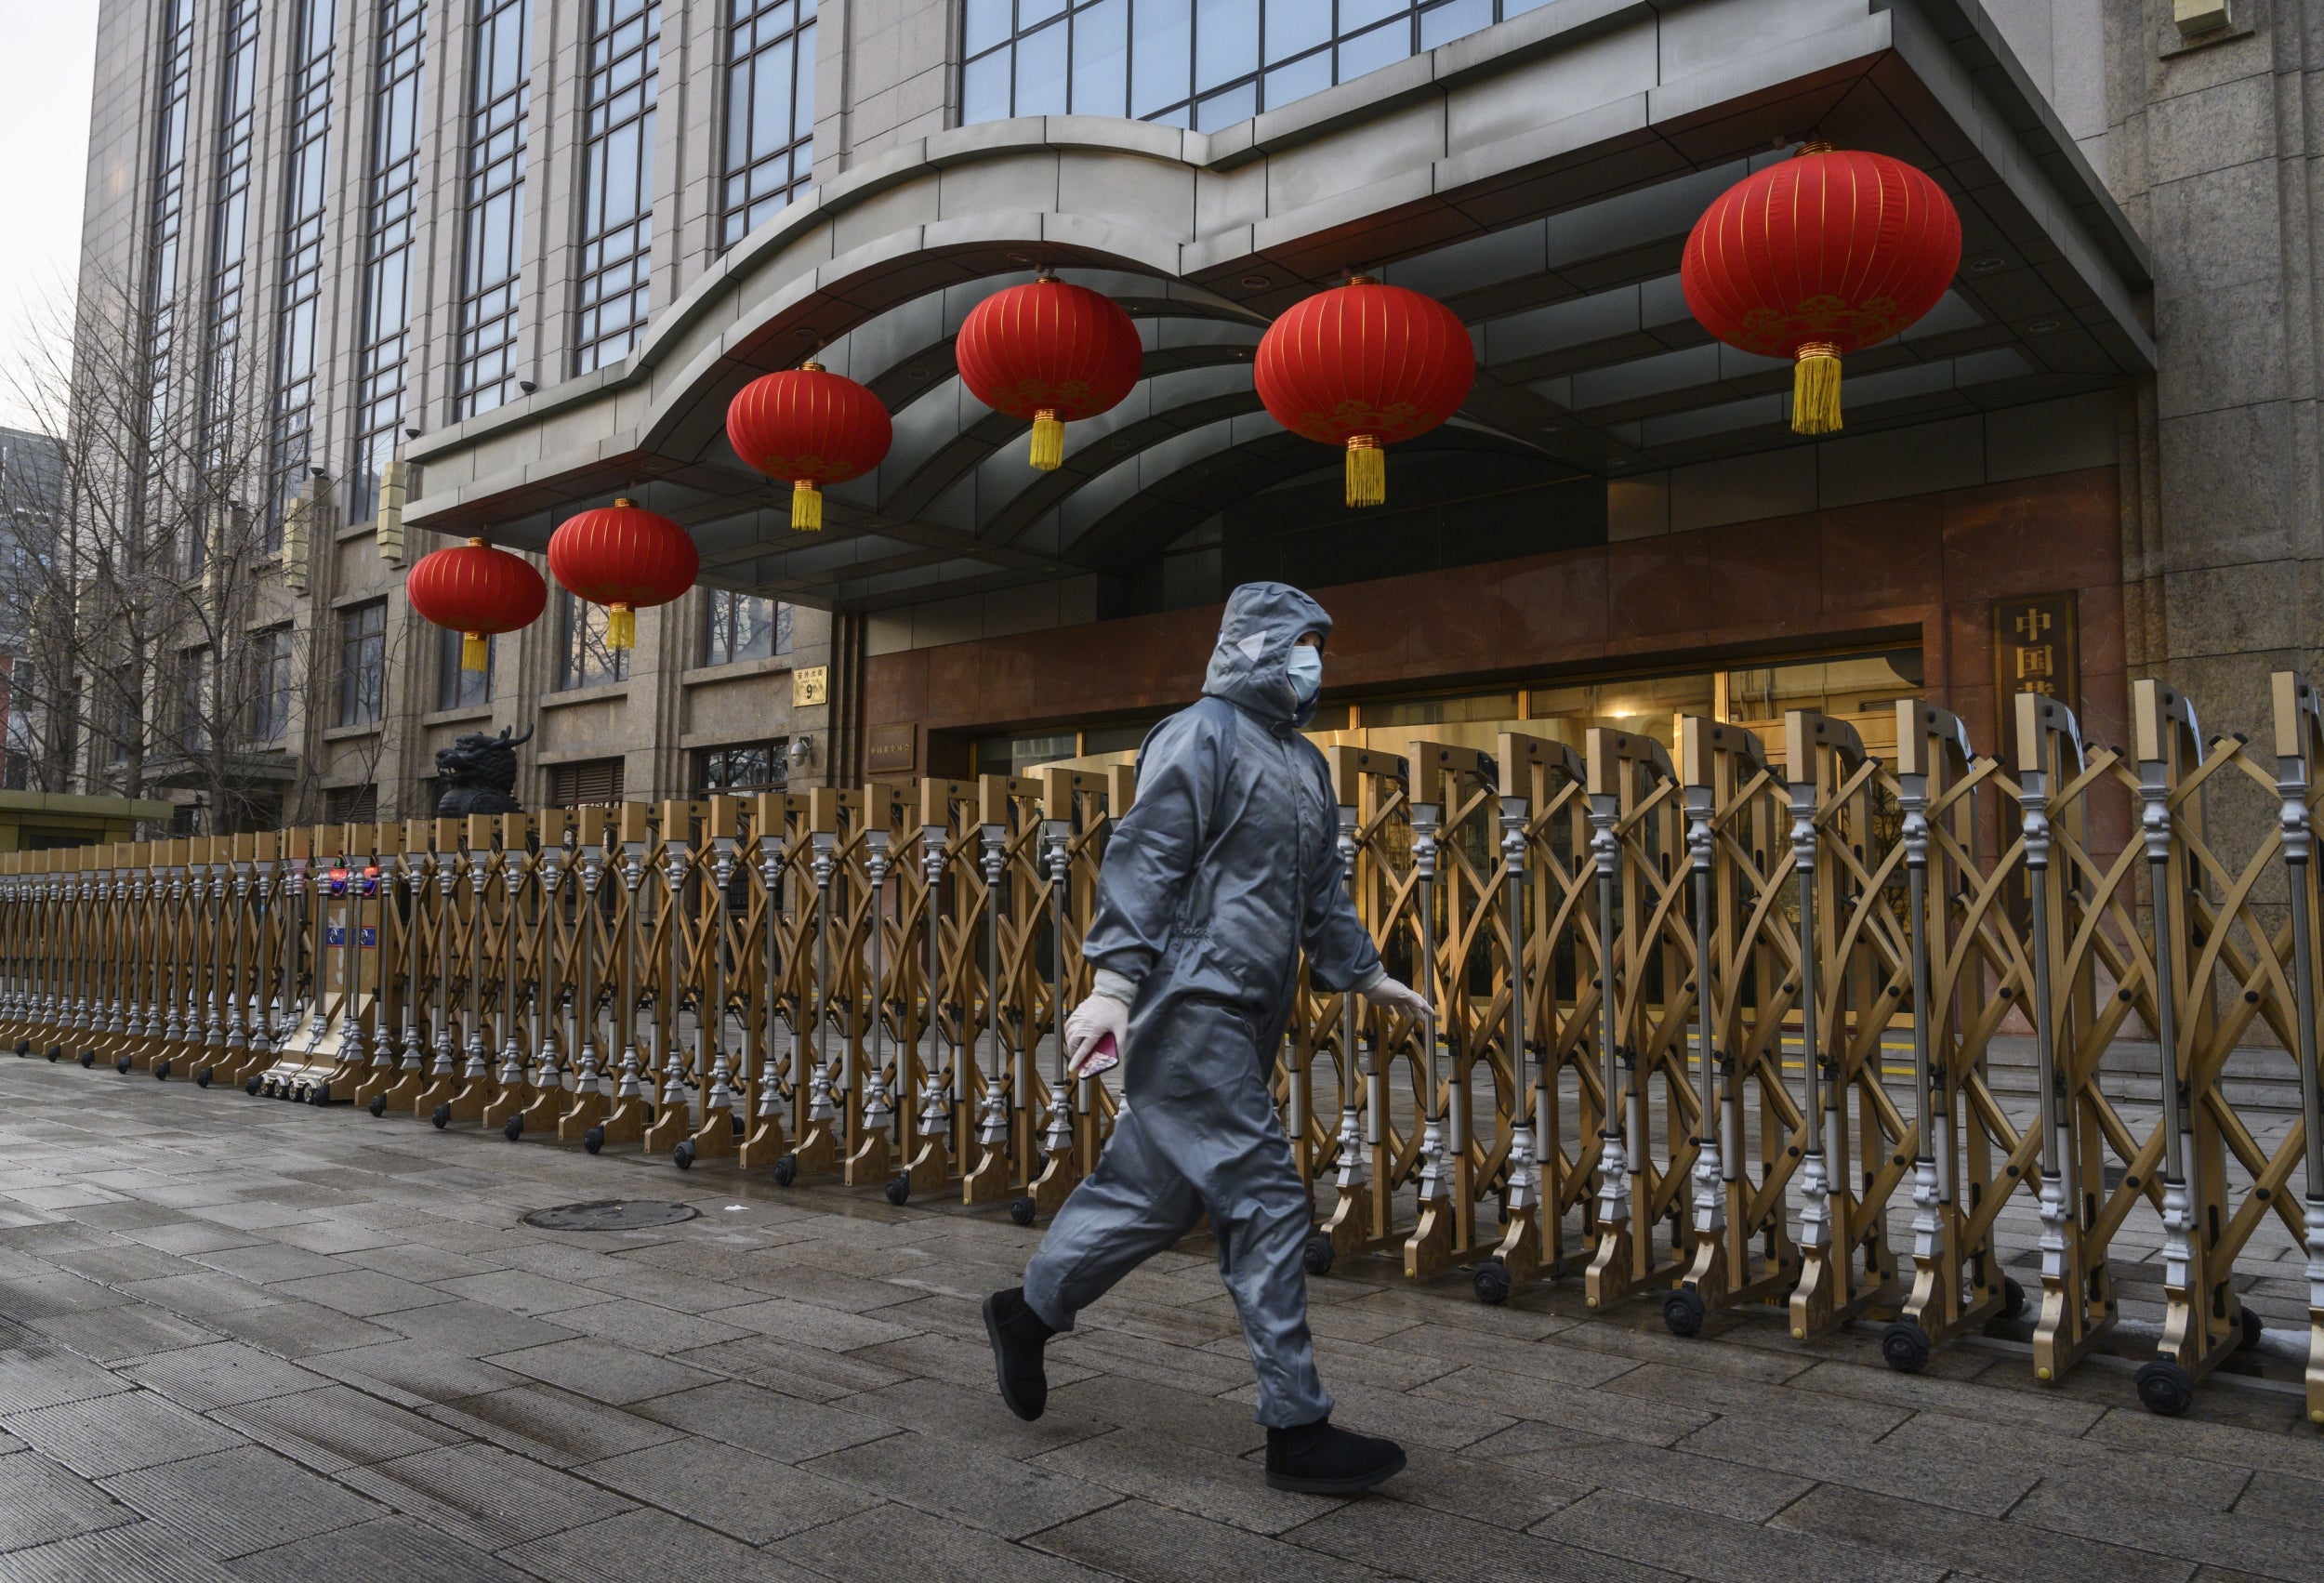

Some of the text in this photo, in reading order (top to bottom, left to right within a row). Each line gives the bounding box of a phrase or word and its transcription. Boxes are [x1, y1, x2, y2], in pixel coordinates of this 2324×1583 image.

[798, 668, 824, 679] 安外大街
[806, 684, 812, 699] 9
